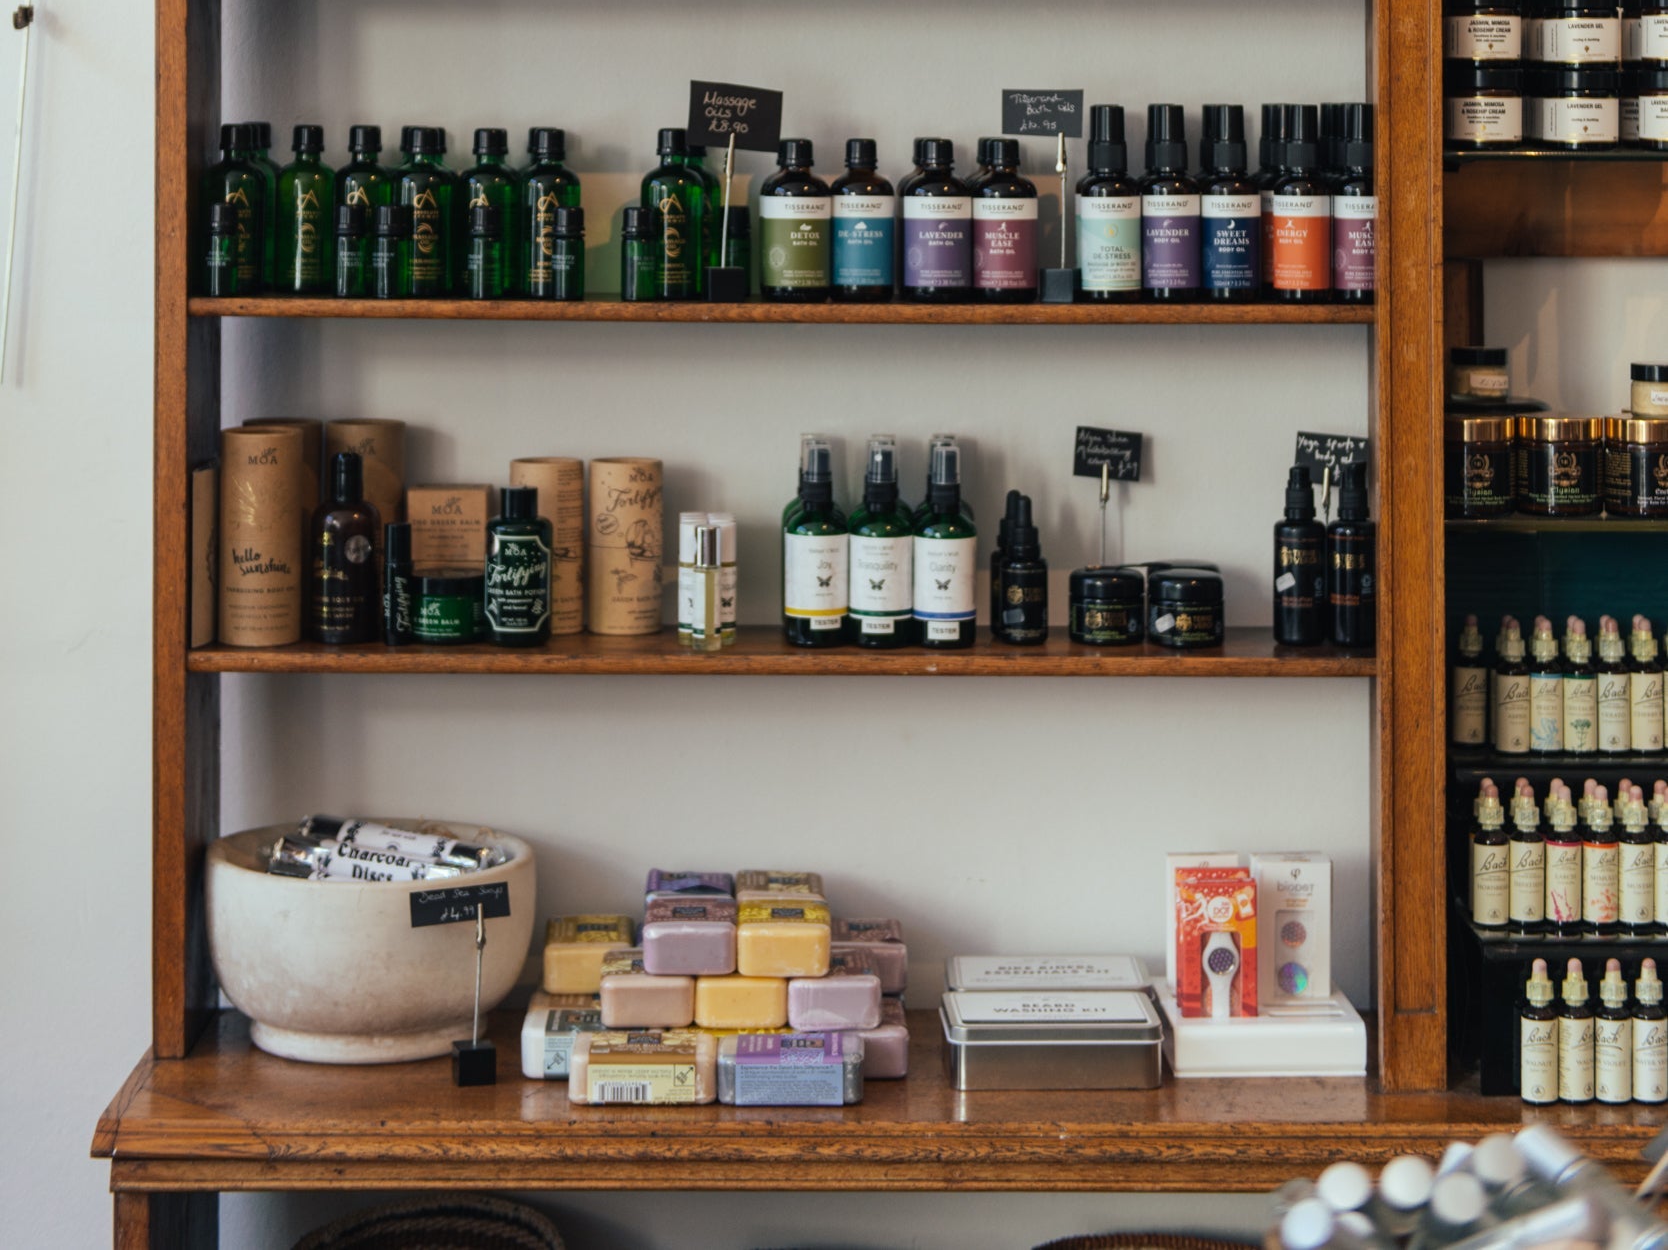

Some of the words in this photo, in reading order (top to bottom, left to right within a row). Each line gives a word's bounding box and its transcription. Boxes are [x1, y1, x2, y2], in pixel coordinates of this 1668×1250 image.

[703, 91, 757, 117] Massage
[984, 232, 1020, 240] MUSCLE
[1146, 229, 1189, 237] LAVENDER
[1348, 231, 1373, 239] MUSC
[1213, 237, 1250, 245] DREAMS
[248, 456, 278, 465] MOA
[431, 505, 463, 515] MOA
[232, 548, 262, 563] hello
[504, 548, 527, 556] MOA
[488, 562, 547, 586] Fortifying
